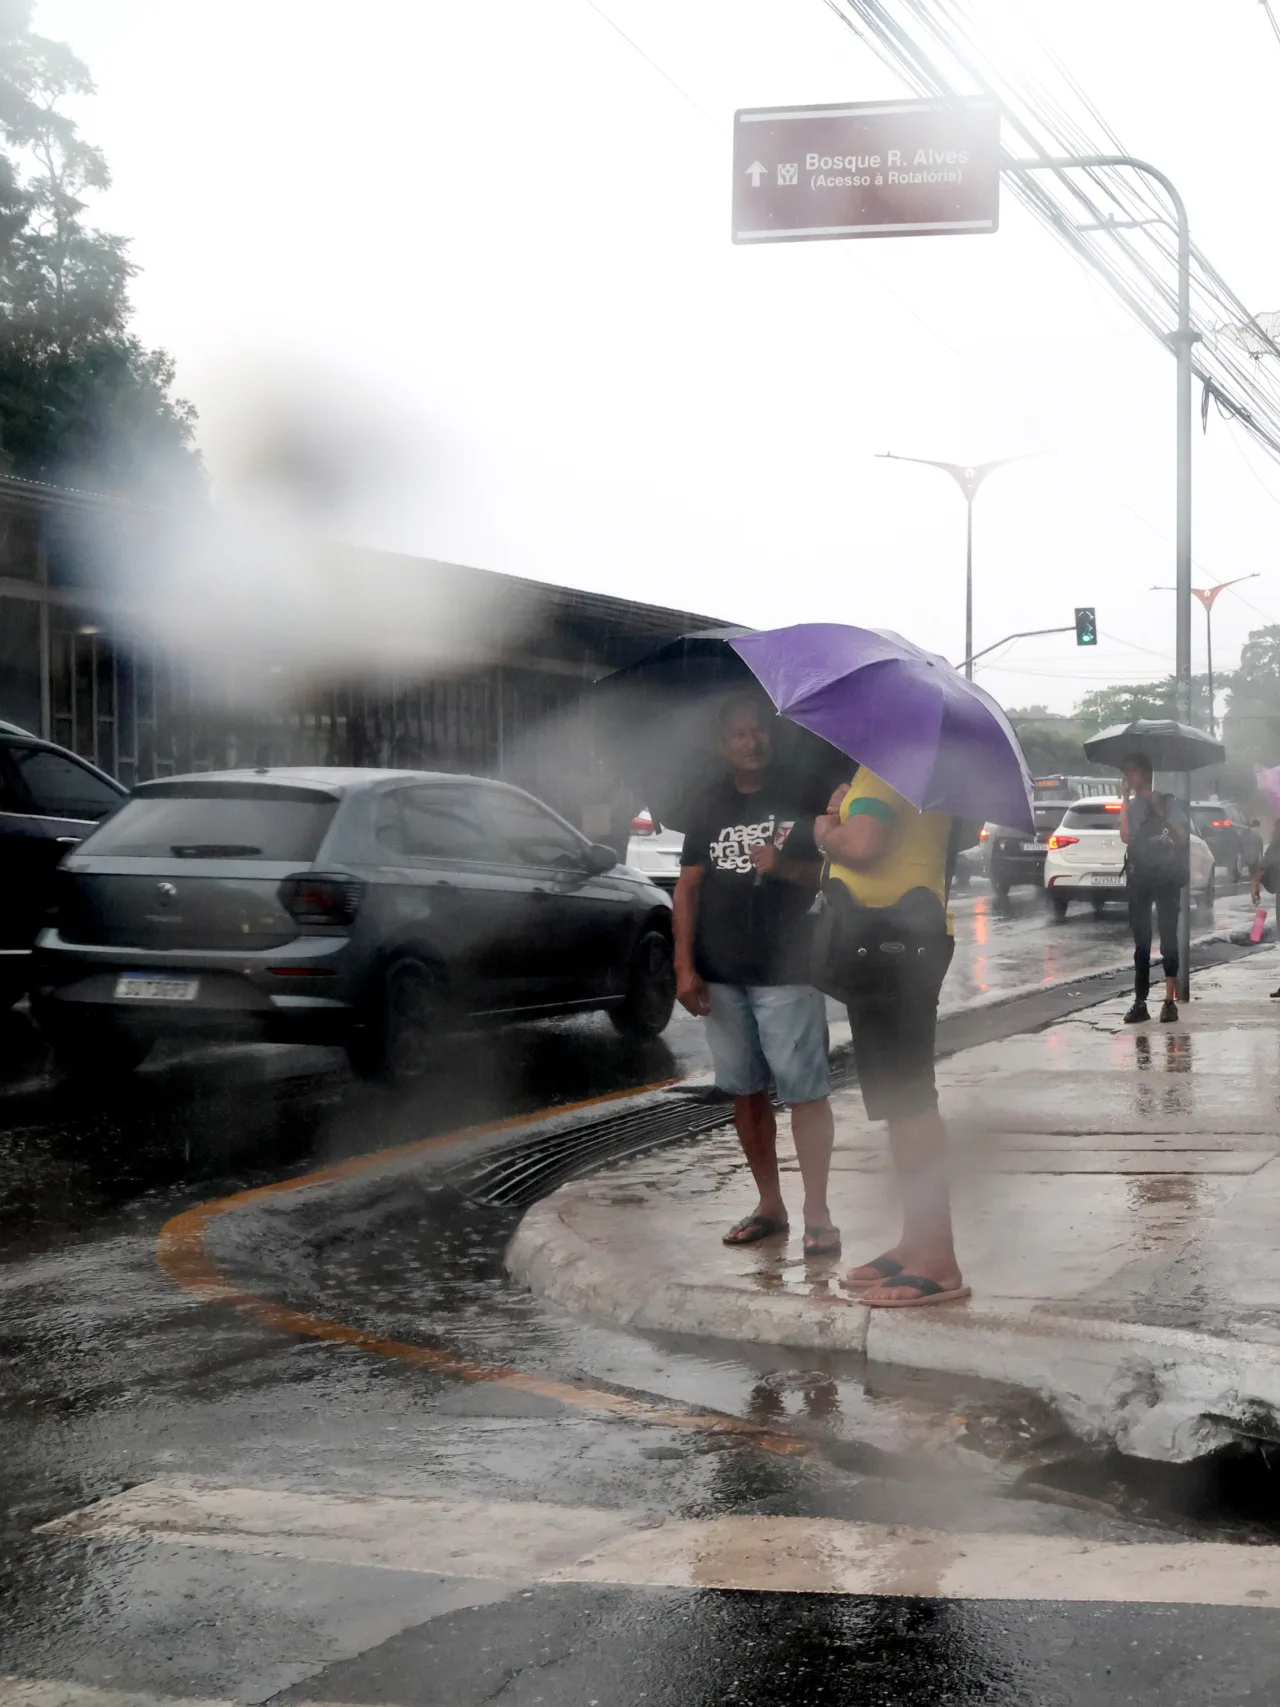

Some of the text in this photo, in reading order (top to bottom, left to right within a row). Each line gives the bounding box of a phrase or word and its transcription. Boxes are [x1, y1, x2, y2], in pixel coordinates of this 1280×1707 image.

[806, 148, 970, 172] Bosque R. Alves
[811, 168, 962, 190] (Acesso à Rotatória)
[718, 814, 775, 842] nasci
[709, 840, 740, 861] pra
